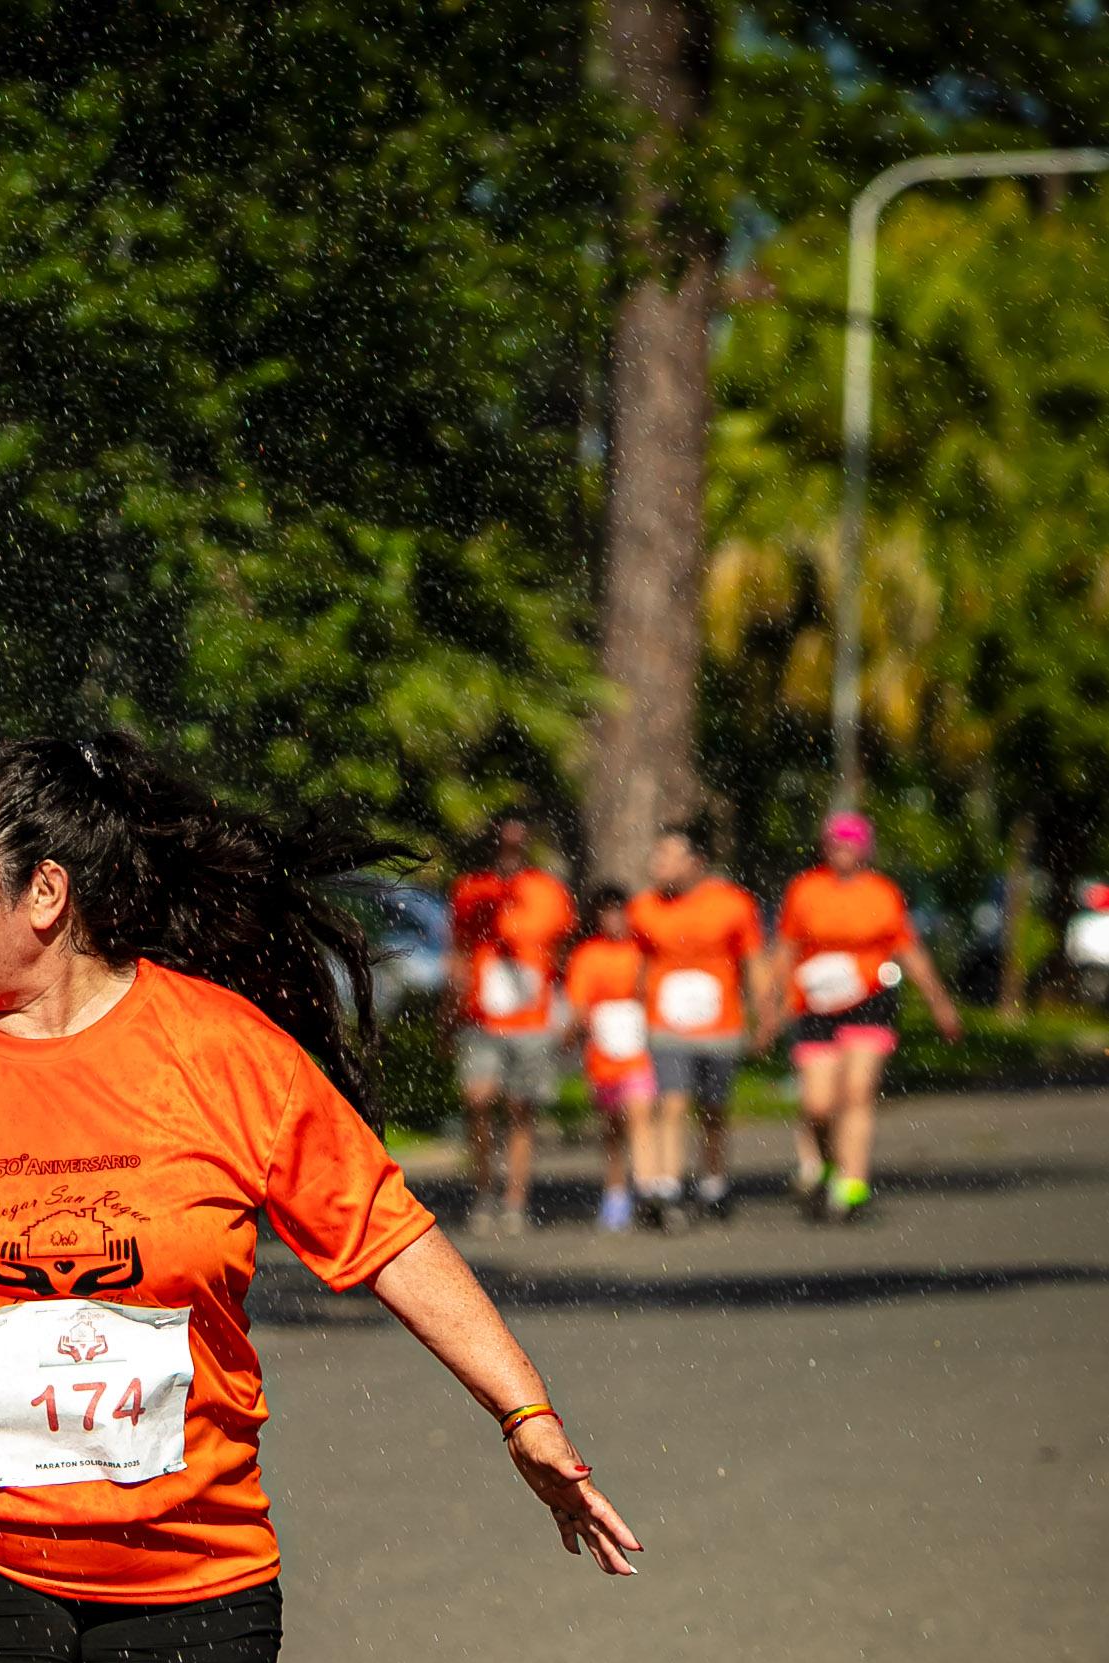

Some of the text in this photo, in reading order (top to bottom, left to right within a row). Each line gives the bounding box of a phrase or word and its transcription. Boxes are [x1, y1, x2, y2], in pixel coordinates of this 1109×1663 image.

[25, 1153, 141, 1176] ANIVERSARIO
[45, 1185, 86, 1206] San
[92, 1190, 151, 1223] Roque
[30, 1377, 147, 1433] 174
[35, 1459, 141, 1470] MARATON SOLIDARIA 2025
